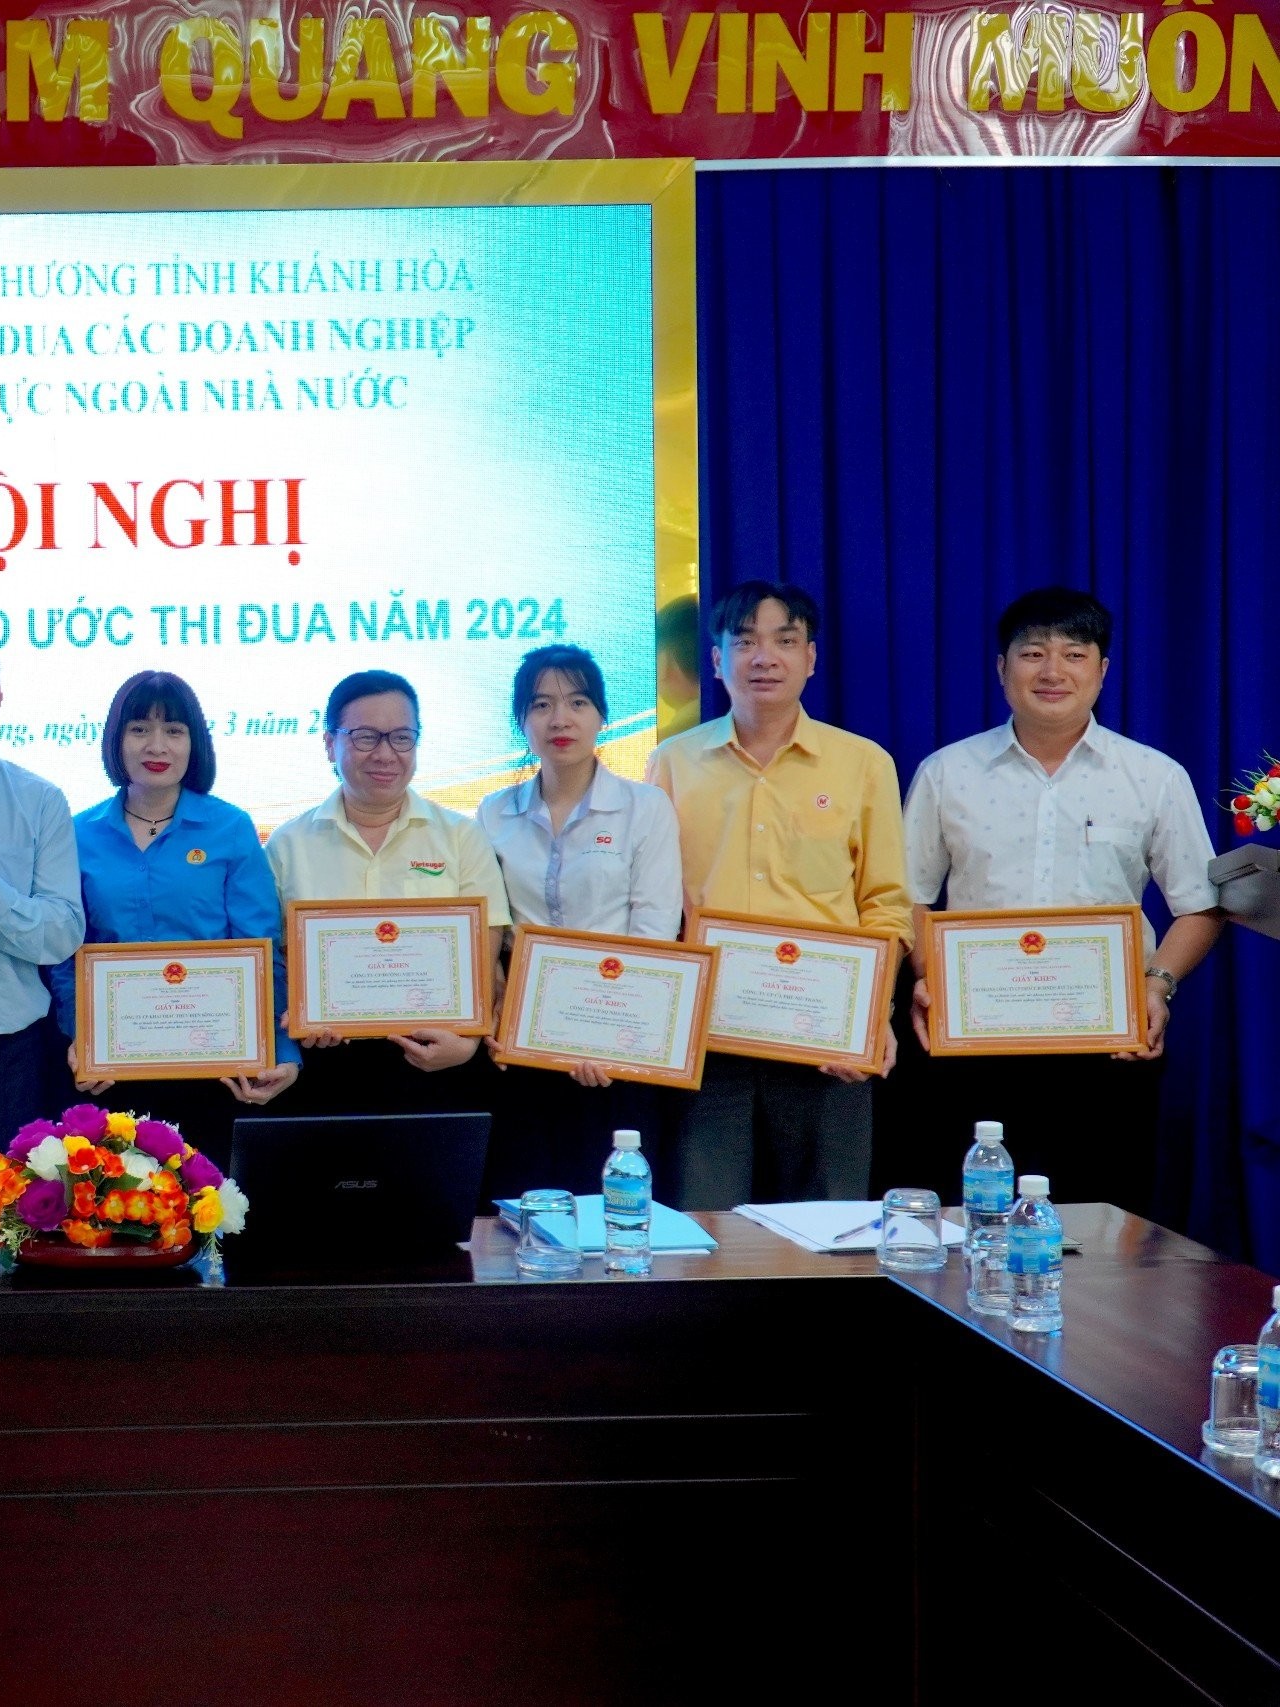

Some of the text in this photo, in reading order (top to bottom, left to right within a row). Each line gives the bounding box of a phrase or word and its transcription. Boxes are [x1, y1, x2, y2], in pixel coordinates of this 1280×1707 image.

[160, 10, 579, 139] QUANG
[632, 12, 914, 114] VINH
[147, 252, 237, 296] TỈNH
[249, 250, 384, 295] KHÁNH
[396, 248, 474, 293] HÒA
[85, 314, 166, 355] CÁC
[178, 319, 316, 354] DOANH
[328, 311, 477, 359] NGHIỆP
[65, 371, 189, 414] NGOÀI
[202, 369, 284, 412] NHÀ
[296, 367, 409, 410] NƯỚC
[88, 478, 308, 567] NGHỊ
[27, 595, 134, 650] ƯỚC
[149, 604, 222, 646] THI
[236, 602, 337, 645] ĐUA
[348, 588, 452, 642] NĂM
[466, 597, 568, 641] 2024
[245, 711, 299, 736] năm
[783, 984, 805, 992] KHEN
[1034, 974, 1057, 982] KHEN
[605, 999, 628, 1008] KHEN
[334, 1180, 379, 1189] ASUS
